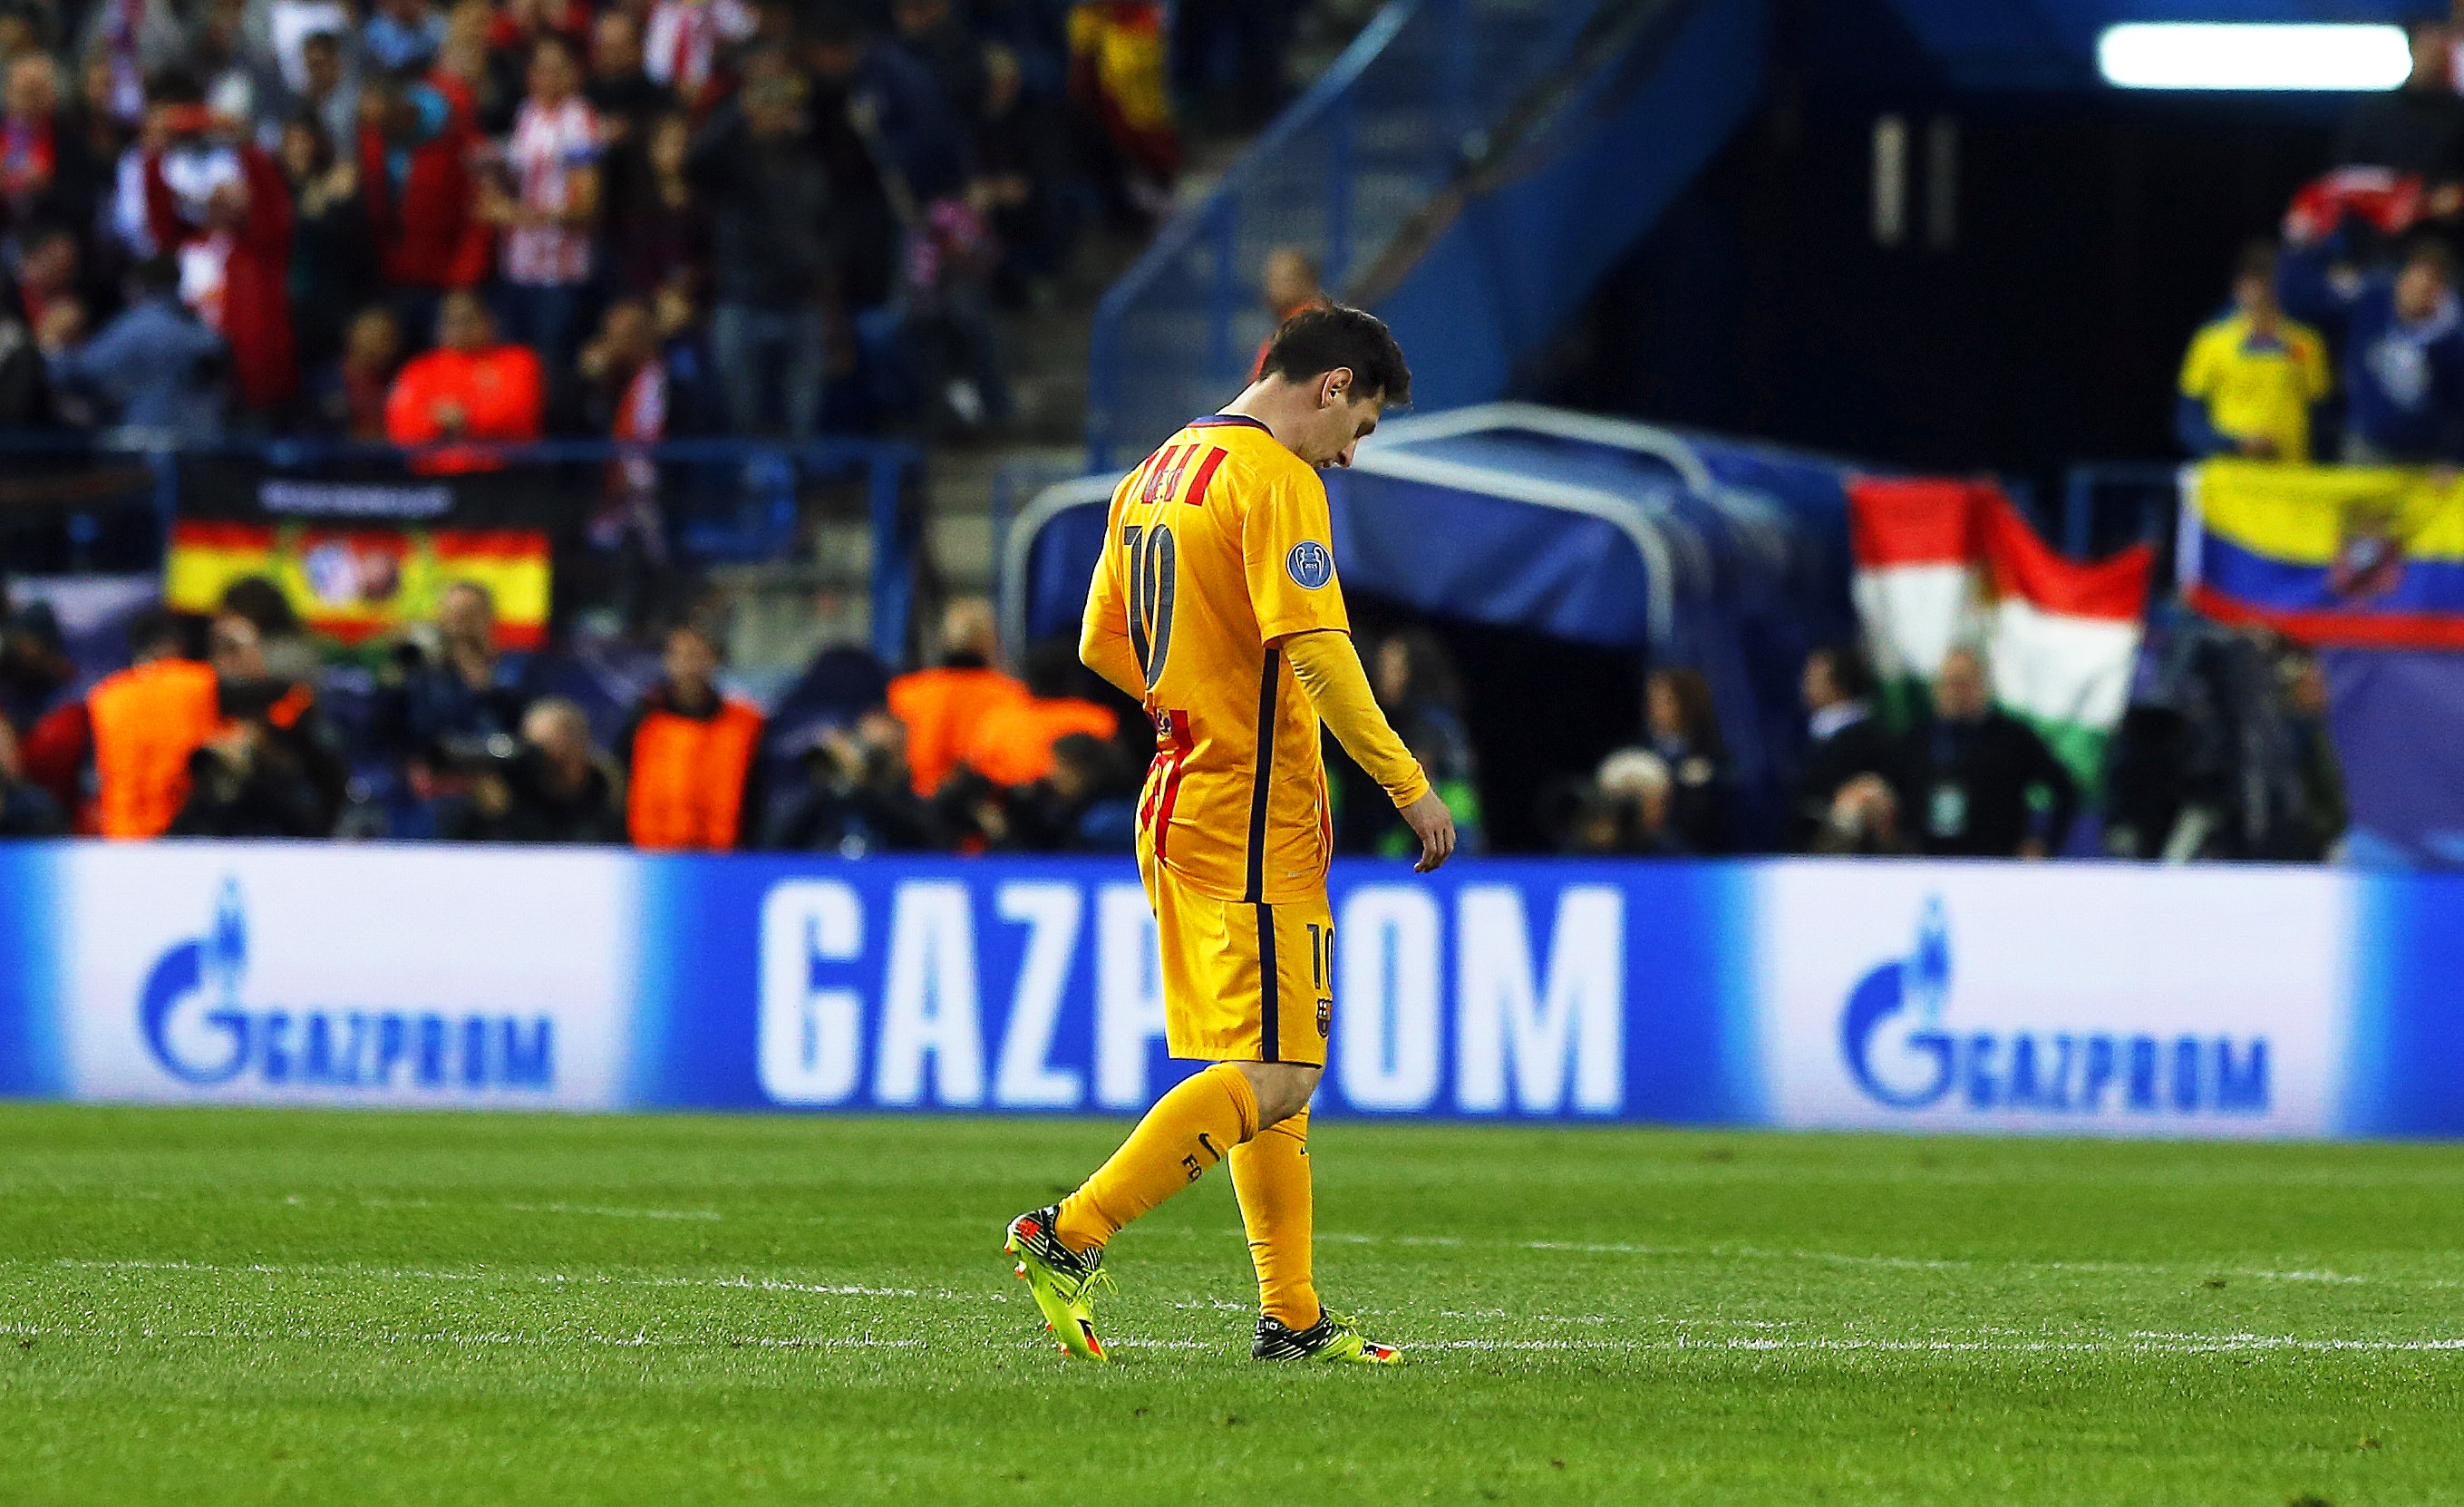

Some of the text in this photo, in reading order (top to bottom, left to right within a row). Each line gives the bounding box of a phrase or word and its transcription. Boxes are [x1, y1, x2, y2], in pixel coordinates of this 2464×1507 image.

[1124, 524, 1176, 690] 10
[1306, 923, 1334, 991] 10
[758, 880, 1623, 1116] GAZPOM
[260, 1011, 556, 1091] GAZPROM
[1964, 1033, 2269, 1113] GAZPROM
